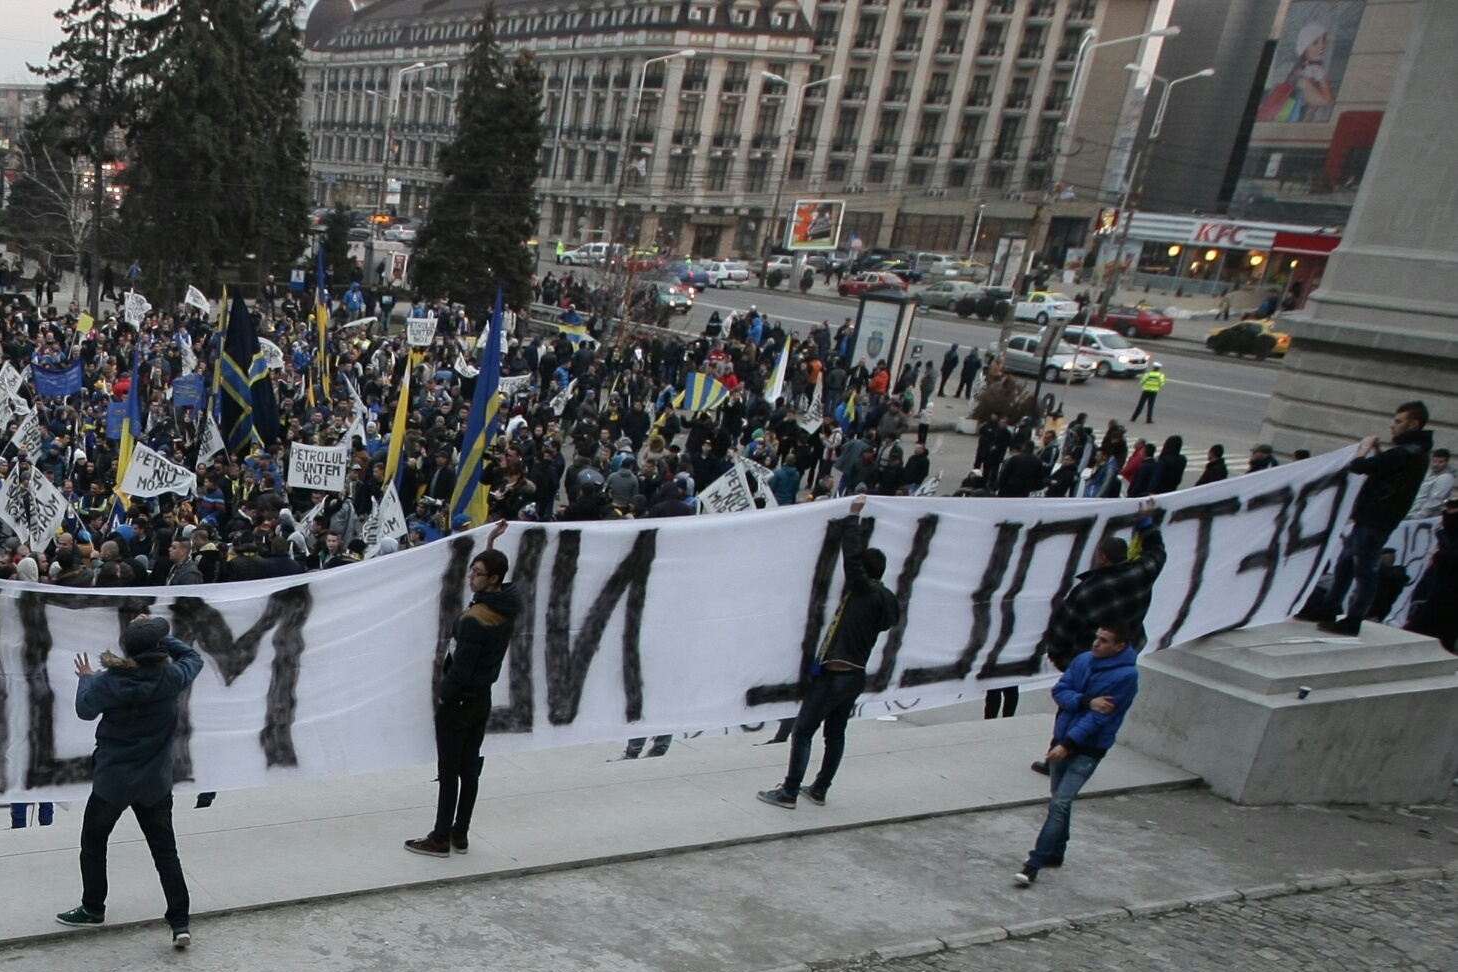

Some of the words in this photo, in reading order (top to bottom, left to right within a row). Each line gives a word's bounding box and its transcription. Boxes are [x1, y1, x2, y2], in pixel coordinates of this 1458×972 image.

[1194, 223, 1249, 246] KFC
[291, 448, 345, 464] PETROLUL
[153, 469, 177, 484] NU
[295, 461, 340, 477] SUNTEM
